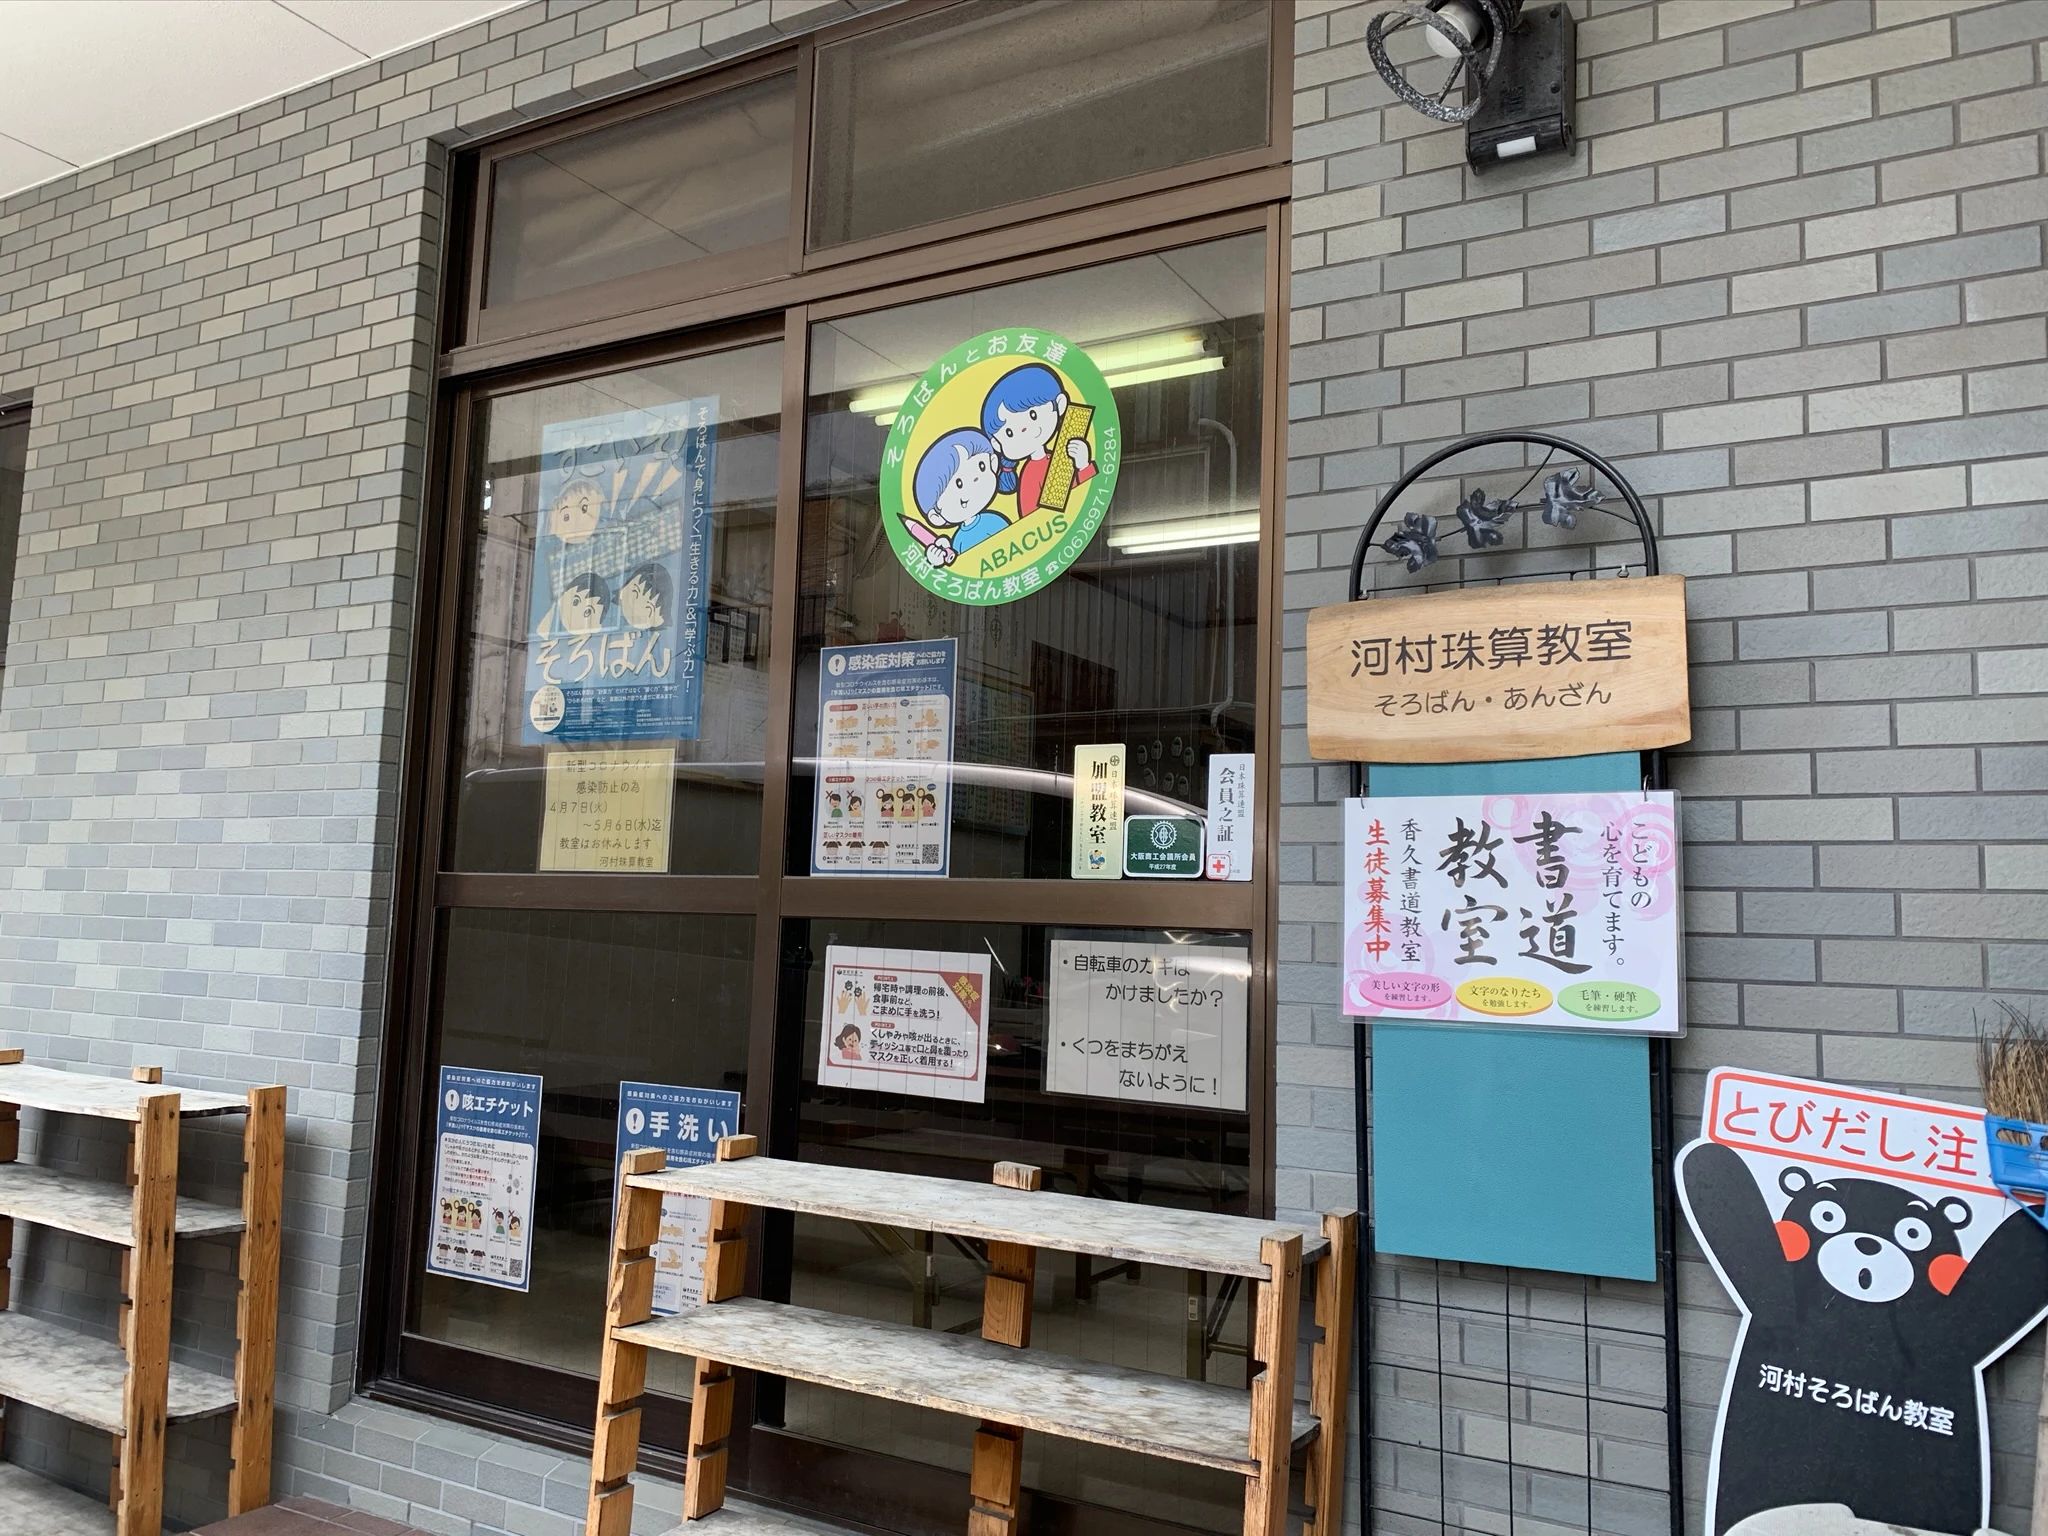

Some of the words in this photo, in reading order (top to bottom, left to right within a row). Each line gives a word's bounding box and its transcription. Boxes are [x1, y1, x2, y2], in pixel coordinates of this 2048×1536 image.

[886, 333, 1068, 468] そろばんとお友達
[1056, 426, 1116, 567] (06)6971-6284
[901, 541, 1042, 601] 河村そろばん教室
[978, 514, 1069, 578] ABACUS
[535, 631, 672, 685] そろばん
[848, 652, 915, 671] 感染症対策
[1350, 619, 1632, 678] 河村珠算教室
[1374, 682, 1611, 717] そろばん・あんざん
[576, 781, 641, 794] 感染防止の為
[1089, 760, 1108, 844] 加盟教室
[1217, 767, 1236, 842] 会員之証
[560, 837, 652, 850] 教室はお休みします
[599, 856, 654, 868] 河村珠算教室
[1630, 821, 1653, 909] こどもの
[1363, 818, 1391, 963] 生徒募集中
[1400, 818, 1423, 963] 香久書道教室
[1434, 816, 1509, 967] 教室
[1512, 811, 1593, 974] 書道
[1600, 821, 1626, 966] 心を育てます。
[1371, 978, 1441, 993] 美しい文字の形
[1384, 992, 1432, 1003] を練習します。
[1469, 984, 1542, 1000] 文字のなりたち
[1482, 998, 1533, 1009] を勉強します。
[1578, 989, 1637, 1003] 毛筆・硬筆
[1585, 1003, 1639, 1014] を練習します。
[462, 1093, 534, 1118] 咳エチケット
[649, 1110, 729, 1143] 手洗い
[1723, 1091, 1992, 1178] とびだし注
[1759, 1363, 1955, 1436] 河村そろばん教室
